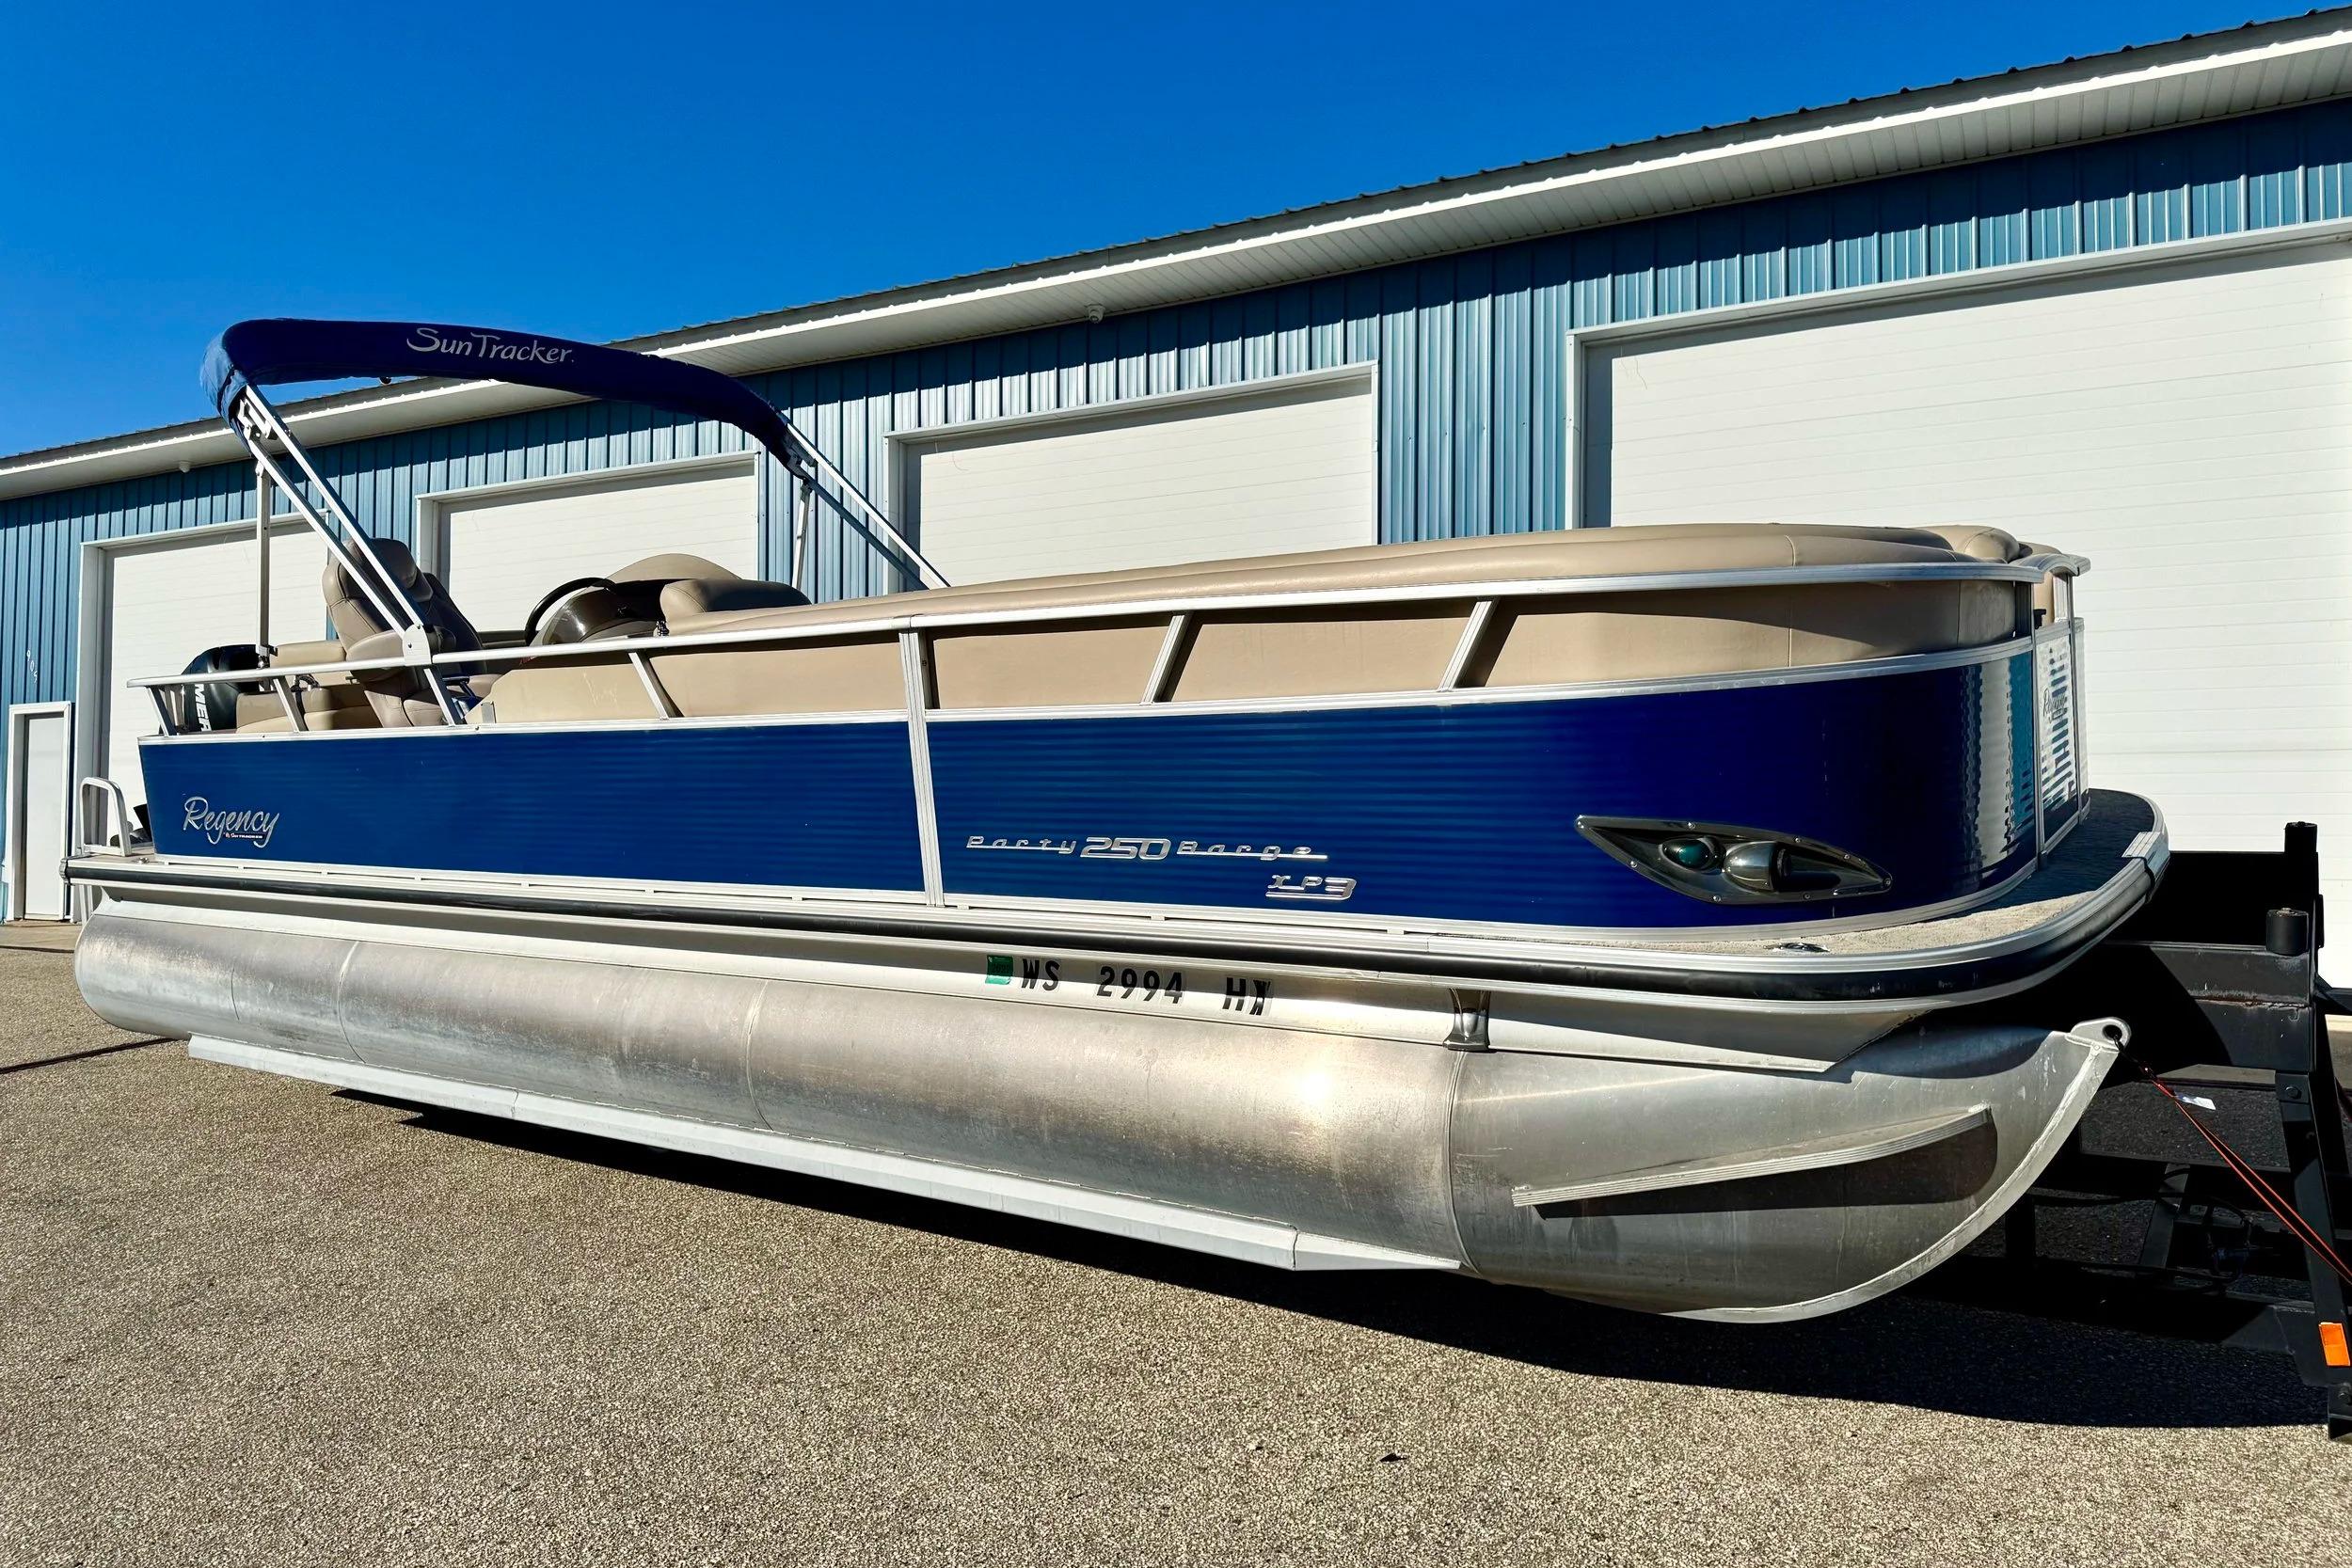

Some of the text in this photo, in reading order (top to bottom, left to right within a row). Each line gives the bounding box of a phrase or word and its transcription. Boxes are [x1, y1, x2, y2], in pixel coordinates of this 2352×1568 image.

[183, 796, 280, 848] Regency
[966, 835, 1327, 861] Party 250 Barge
[1265, 875, 1357, 900] XP3
[1021, 958, 1060, 991] WS
[1096, 965, 1183, 1005] 2994
